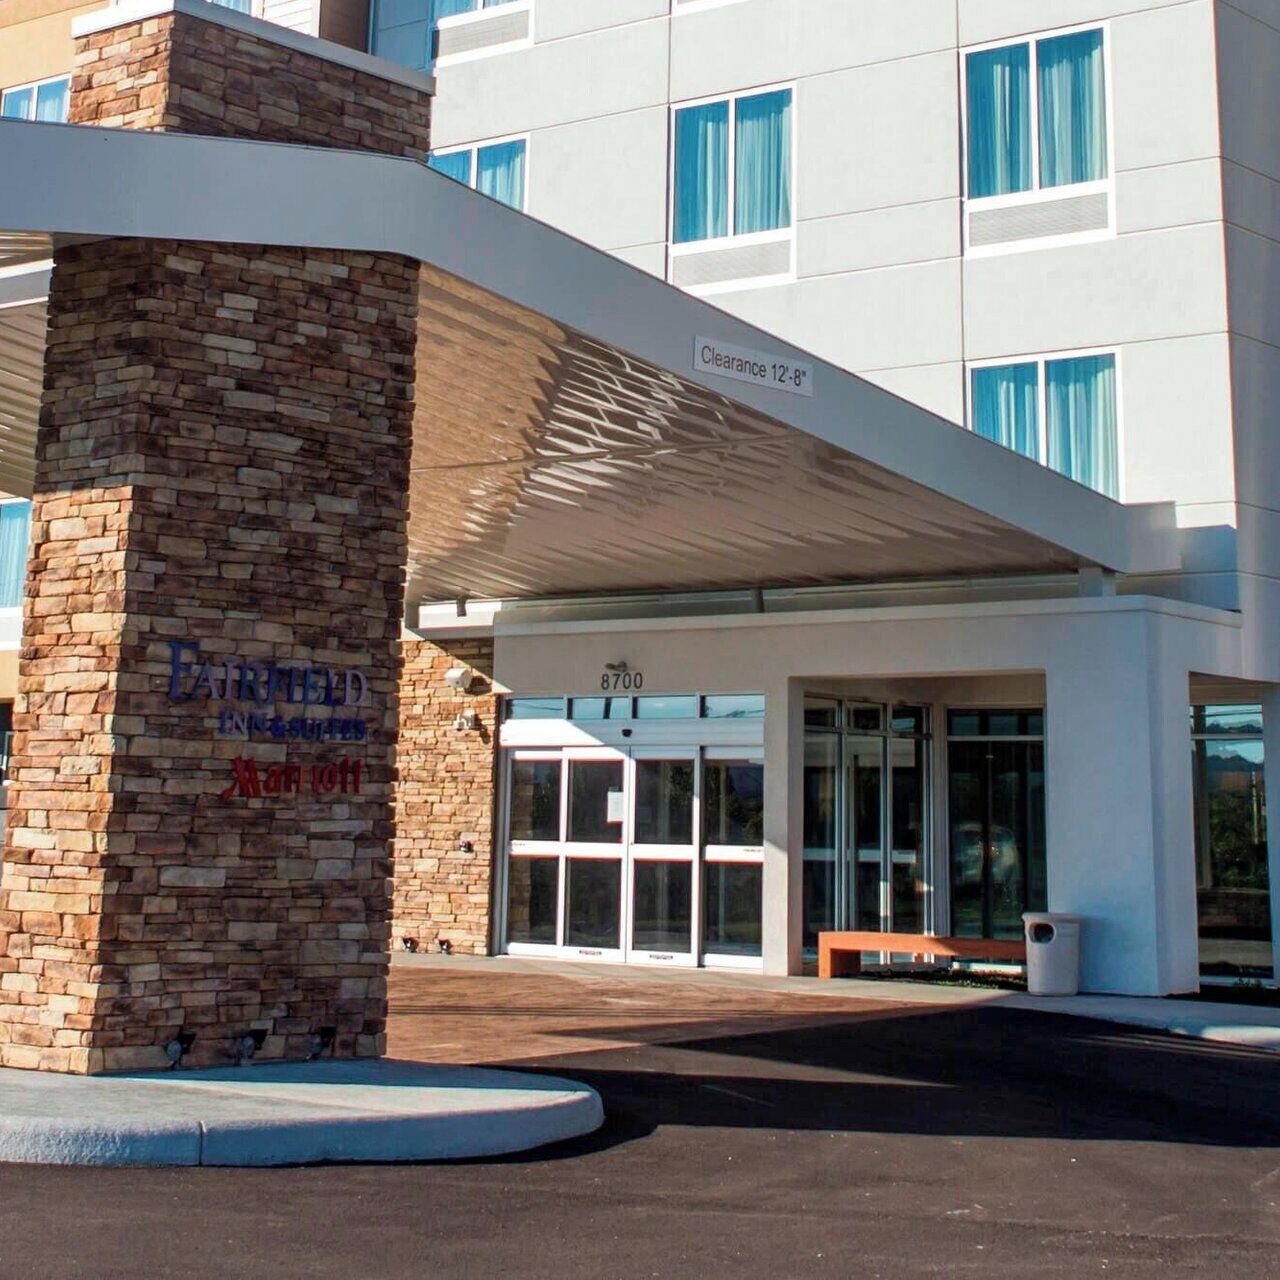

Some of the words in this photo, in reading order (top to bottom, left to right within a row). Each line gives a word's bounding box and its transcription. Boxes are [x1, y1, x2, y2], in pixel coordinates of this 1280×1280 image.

[701, 345, 767, 378] Clearance
[168, 641, 370, 707] FAIRFIELD
[601, 672, 643, 690] 8700
[223, 756, 363, 800] Marriott
